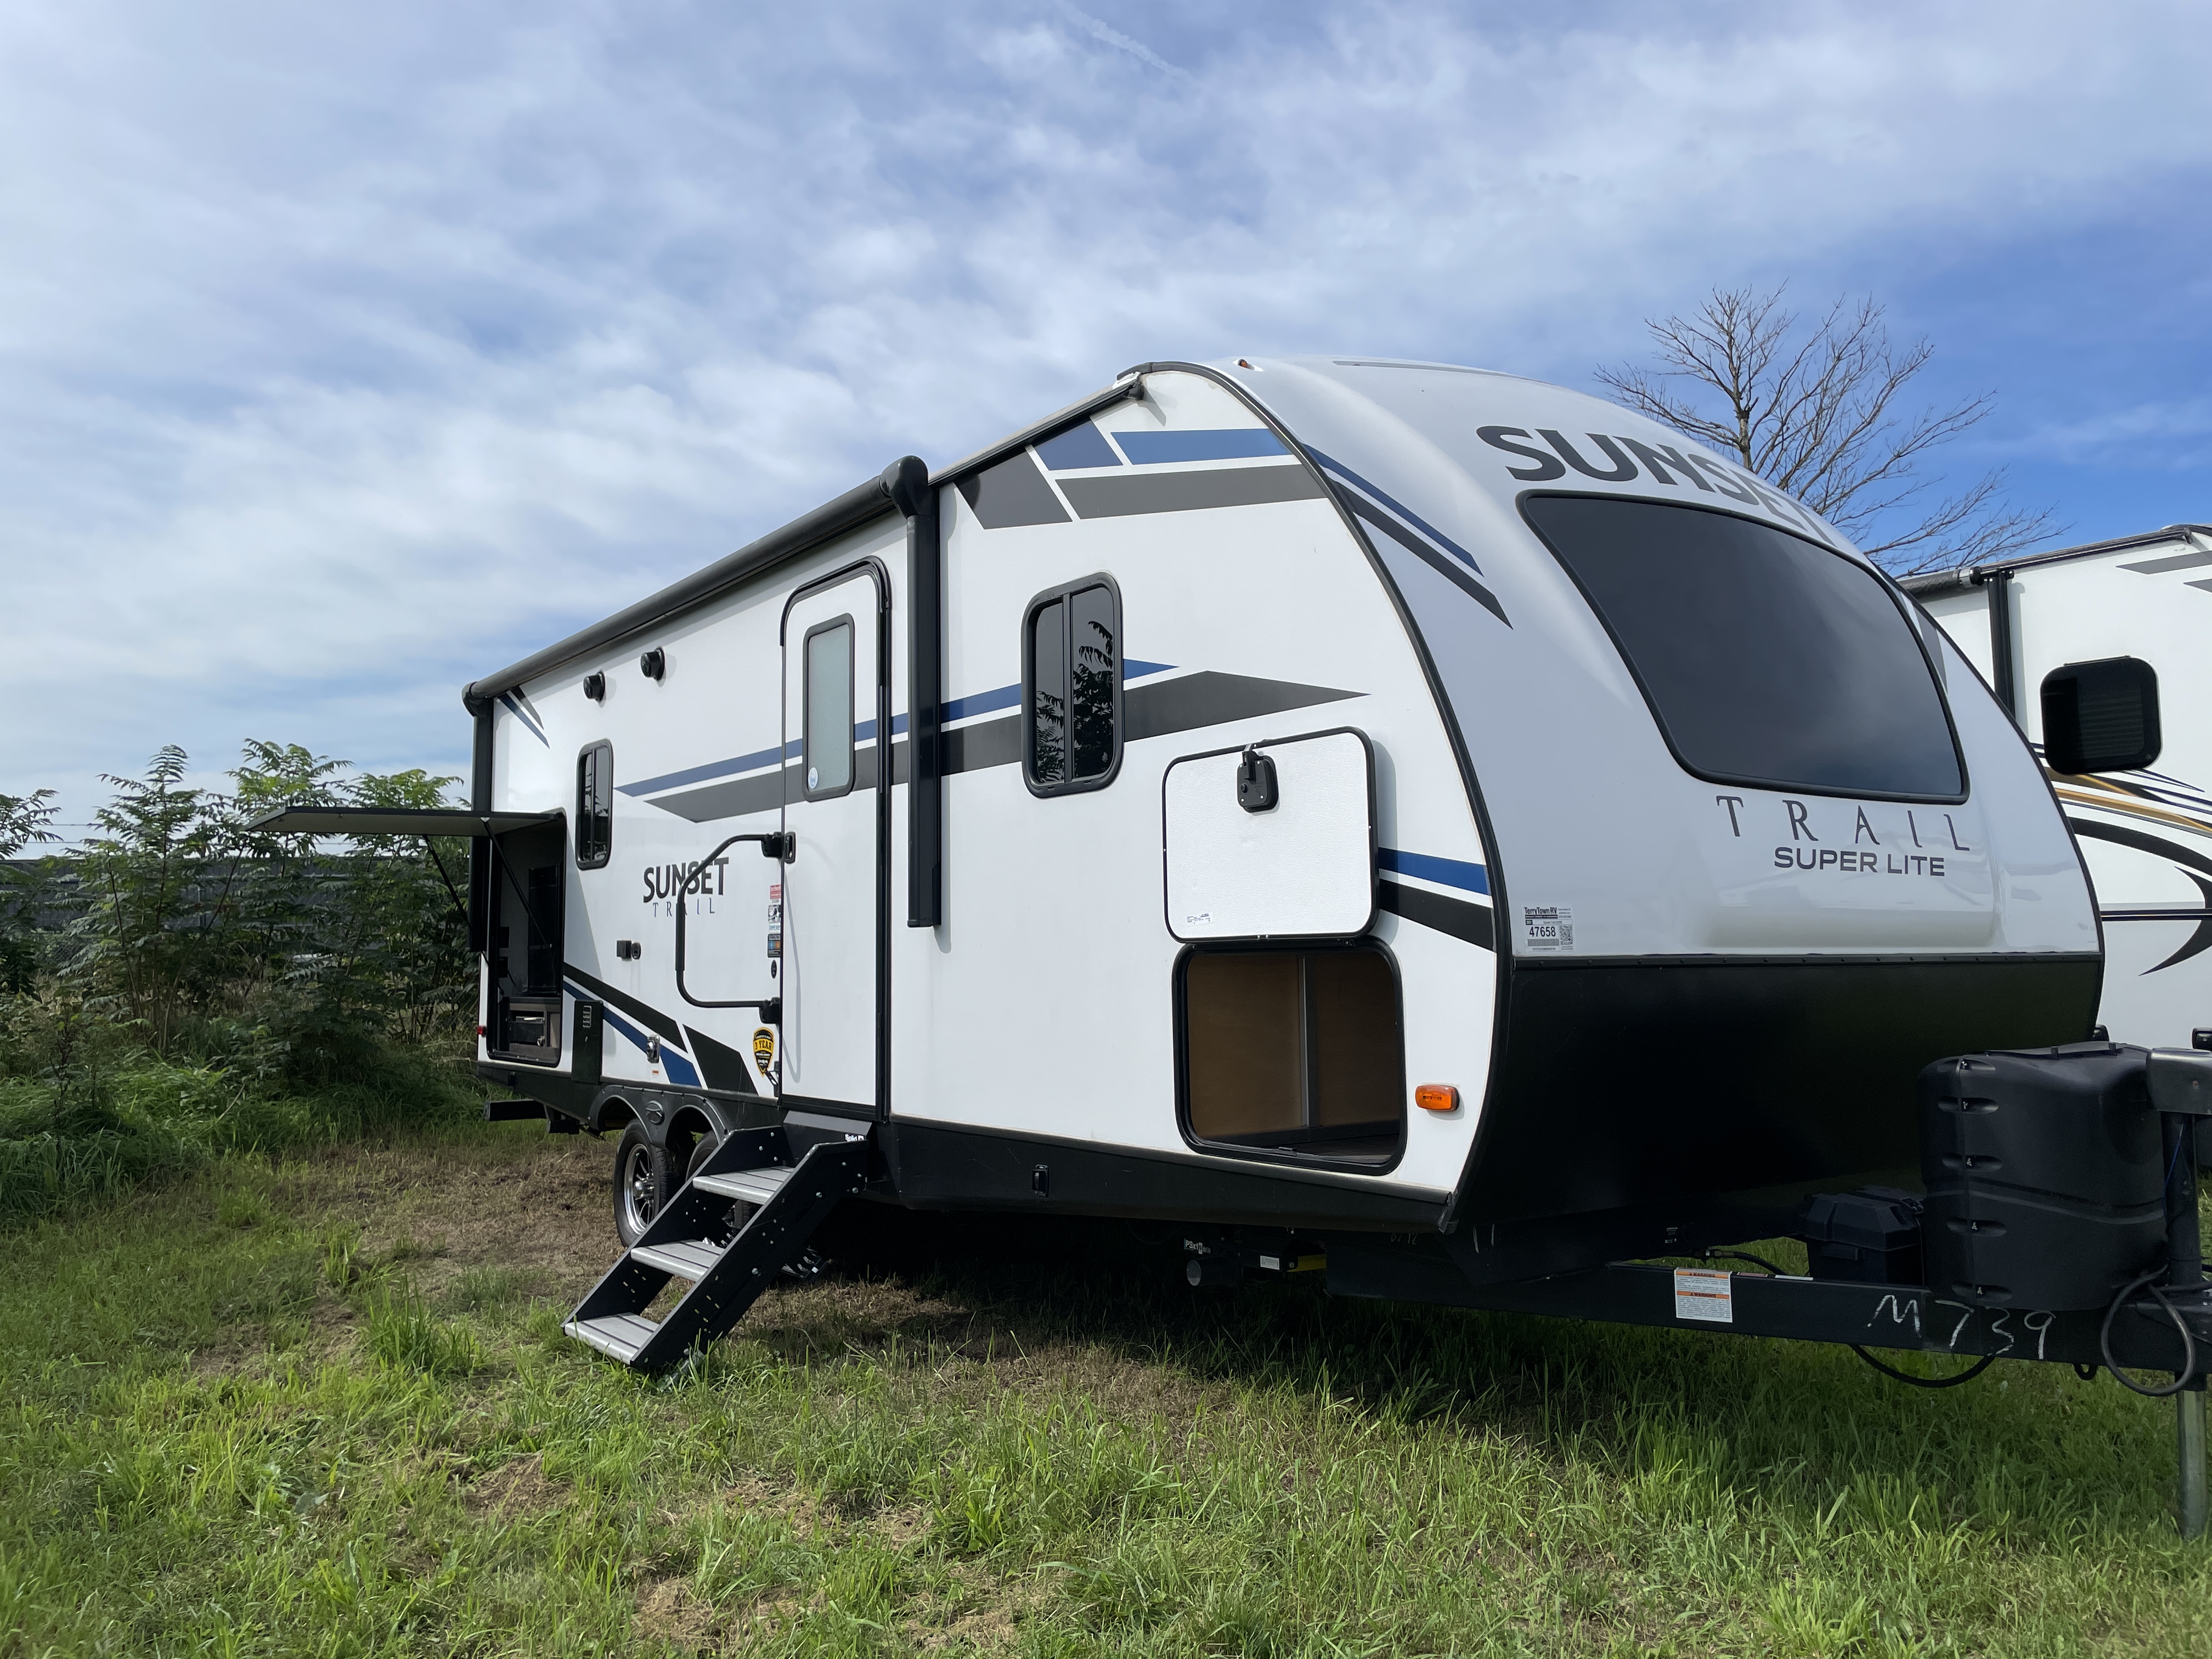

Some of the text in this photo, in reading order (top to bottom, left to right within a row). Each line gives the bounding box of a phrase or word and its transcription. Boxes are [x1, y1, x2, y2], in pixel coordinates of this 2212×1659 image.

[1476, 426, 1839, 549] SUNSET
[1716, 795, 1970, 851] TRAIL
[1774, 847, 1945, 877] SUPER LITE
[644, 857, 729, 903] SUNSET
[652, 898, 715, 918] TRIL
[1524, 907, 1550, 916] TerryTown
[1529, 926, 1556, 937] 47658
[755, 1040, 772, 1051] 3 YEAR
